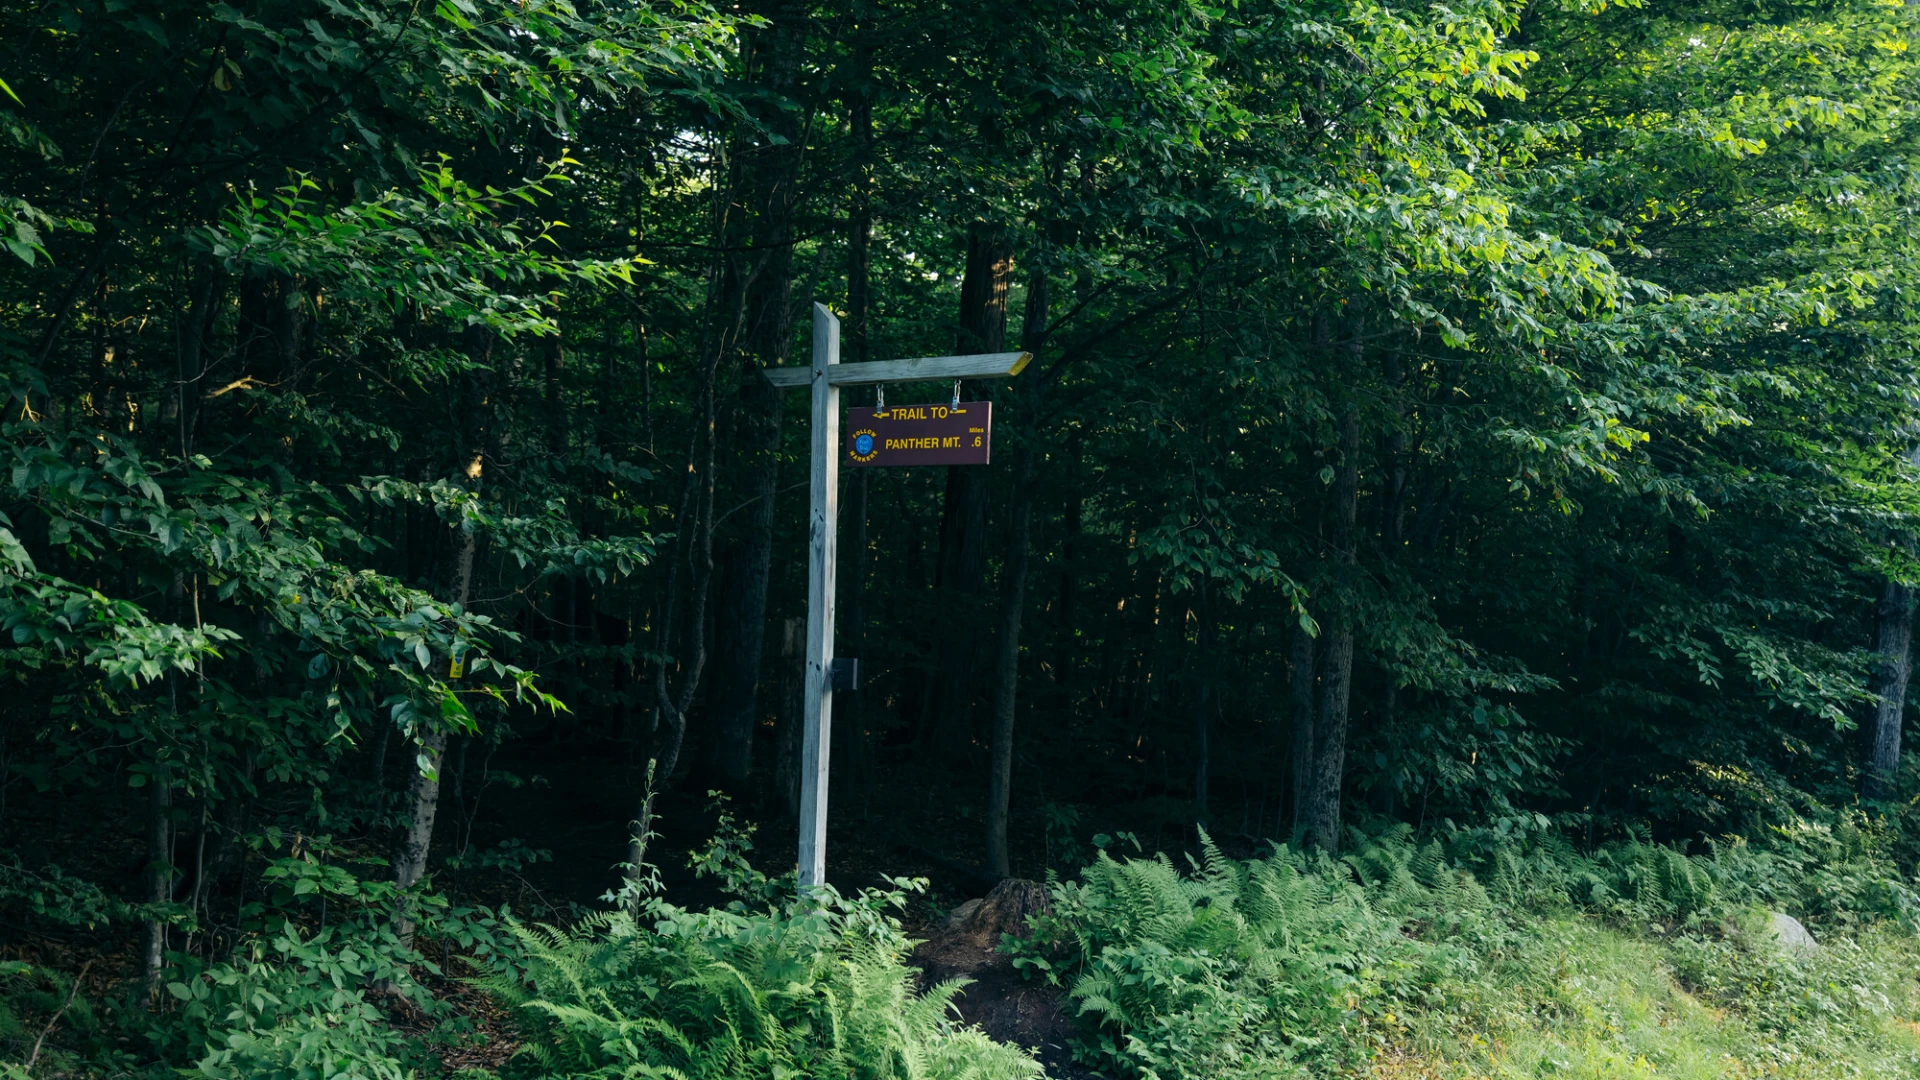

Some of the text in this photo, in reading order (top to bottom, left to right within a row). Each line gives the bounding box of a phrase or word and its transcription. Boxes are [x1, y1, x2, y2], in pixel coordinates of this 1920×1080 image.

[891, 407, 948, 420] TRAIL TO
[852, 429, 877, 439] FOLLOW
[885, 436, 982, 450] PANTHER MT. .6
[849, 450, 878, 462] MARKERS
